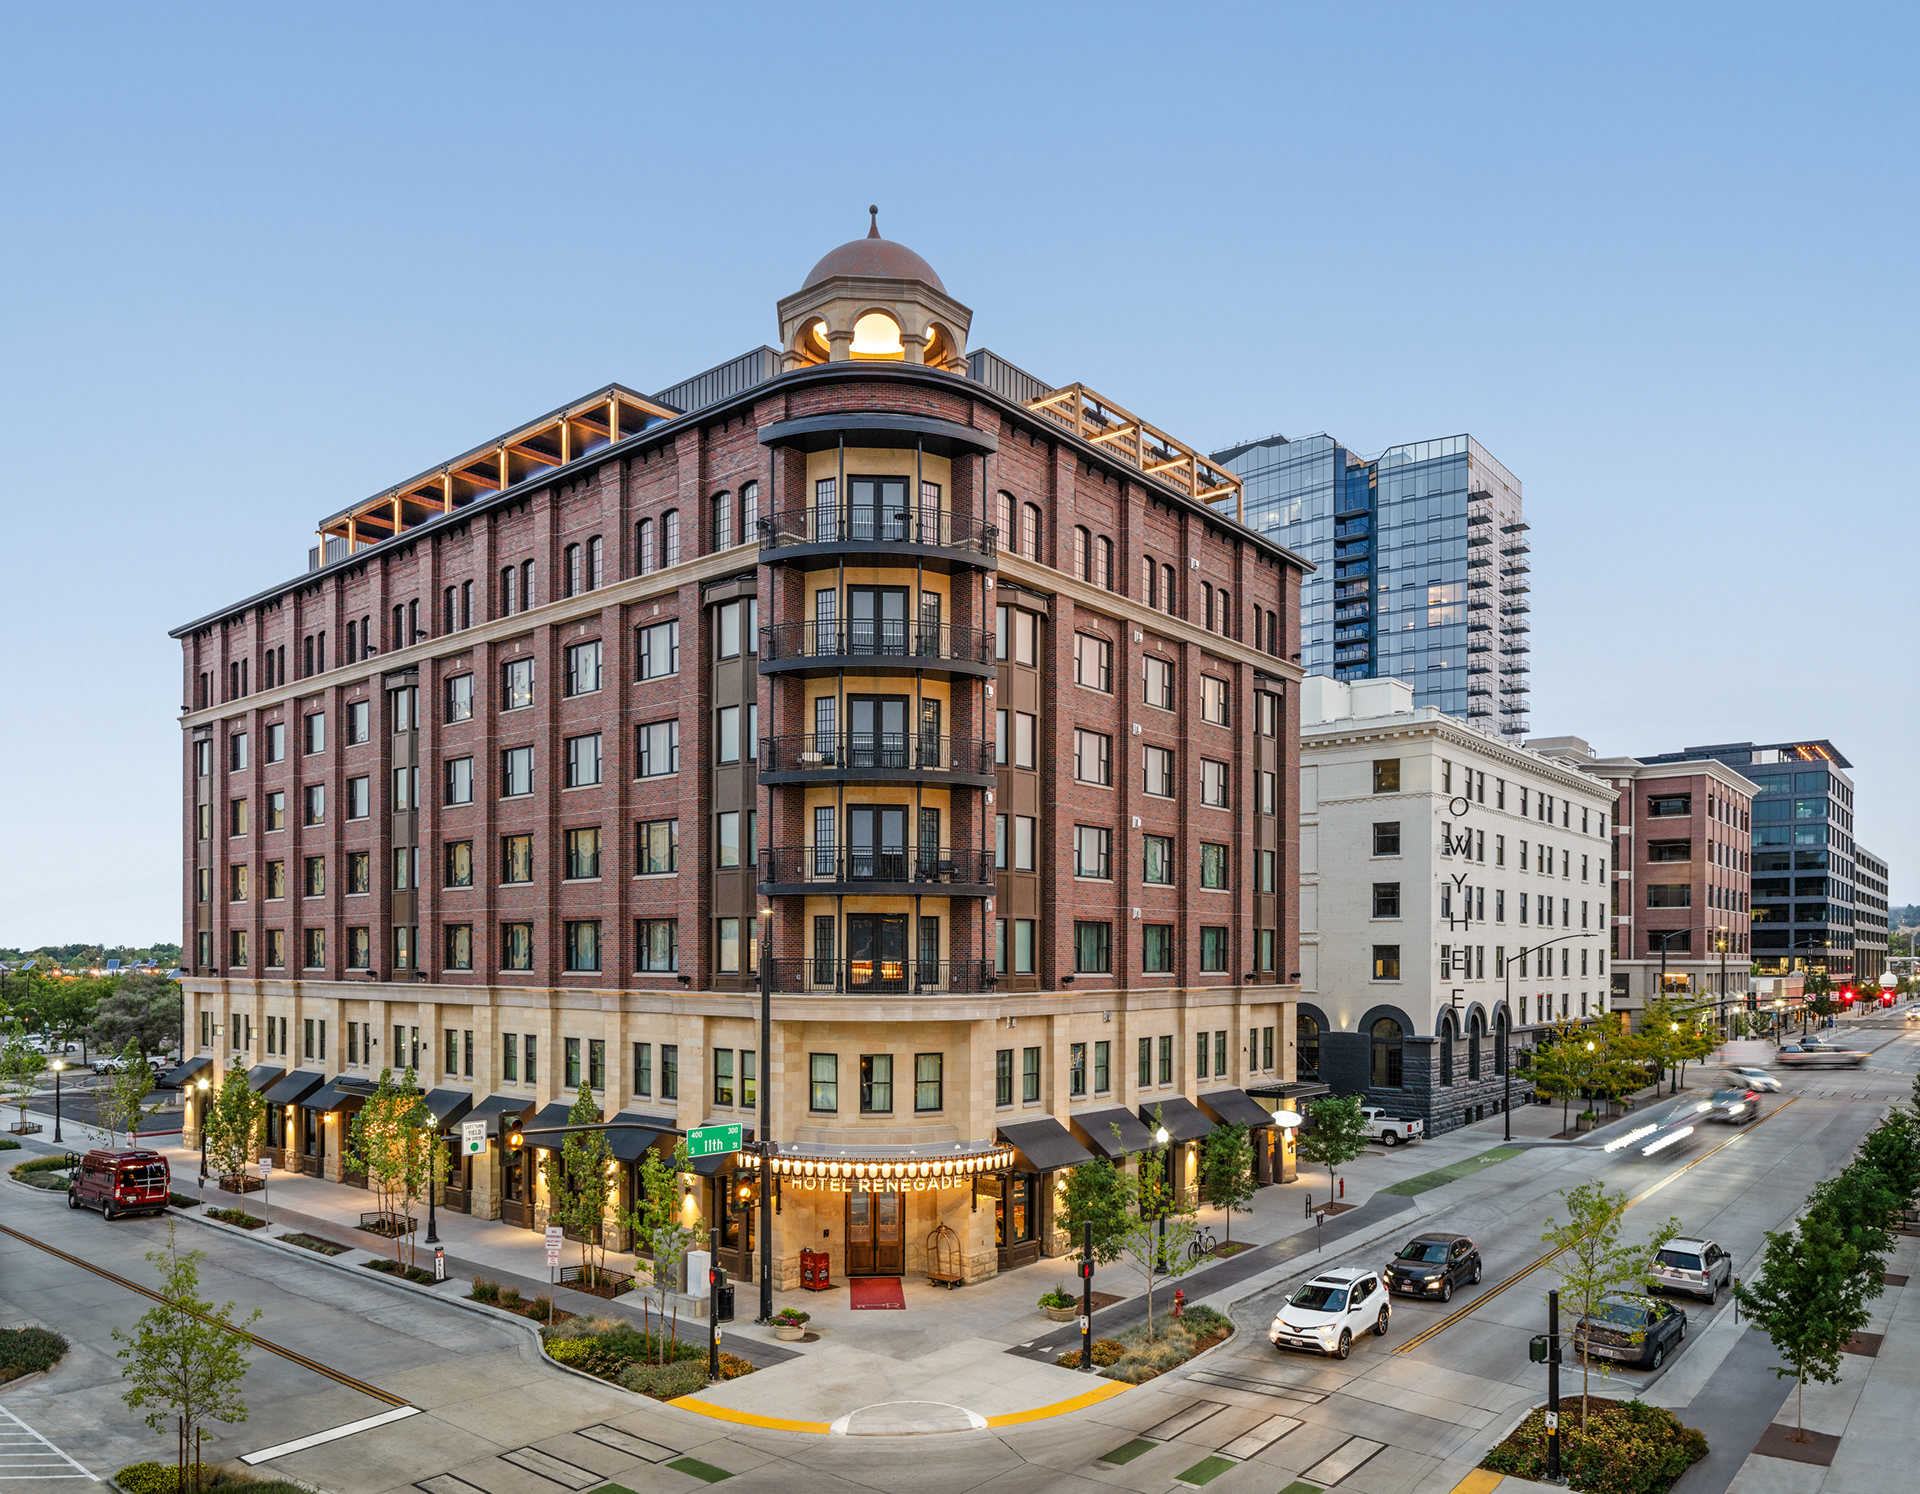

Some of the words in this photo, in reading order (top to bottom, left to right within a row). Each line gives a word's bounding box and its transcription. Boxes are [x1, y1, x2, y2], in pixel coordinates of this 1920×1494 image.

[1448, 796, 1472, 1009] OWYHEE
[704, 1139, 723, 1152] 11th
[791, 1176, 854, 1193] HOTEL
[858, 1175, 964, 1193] RENEGADE
